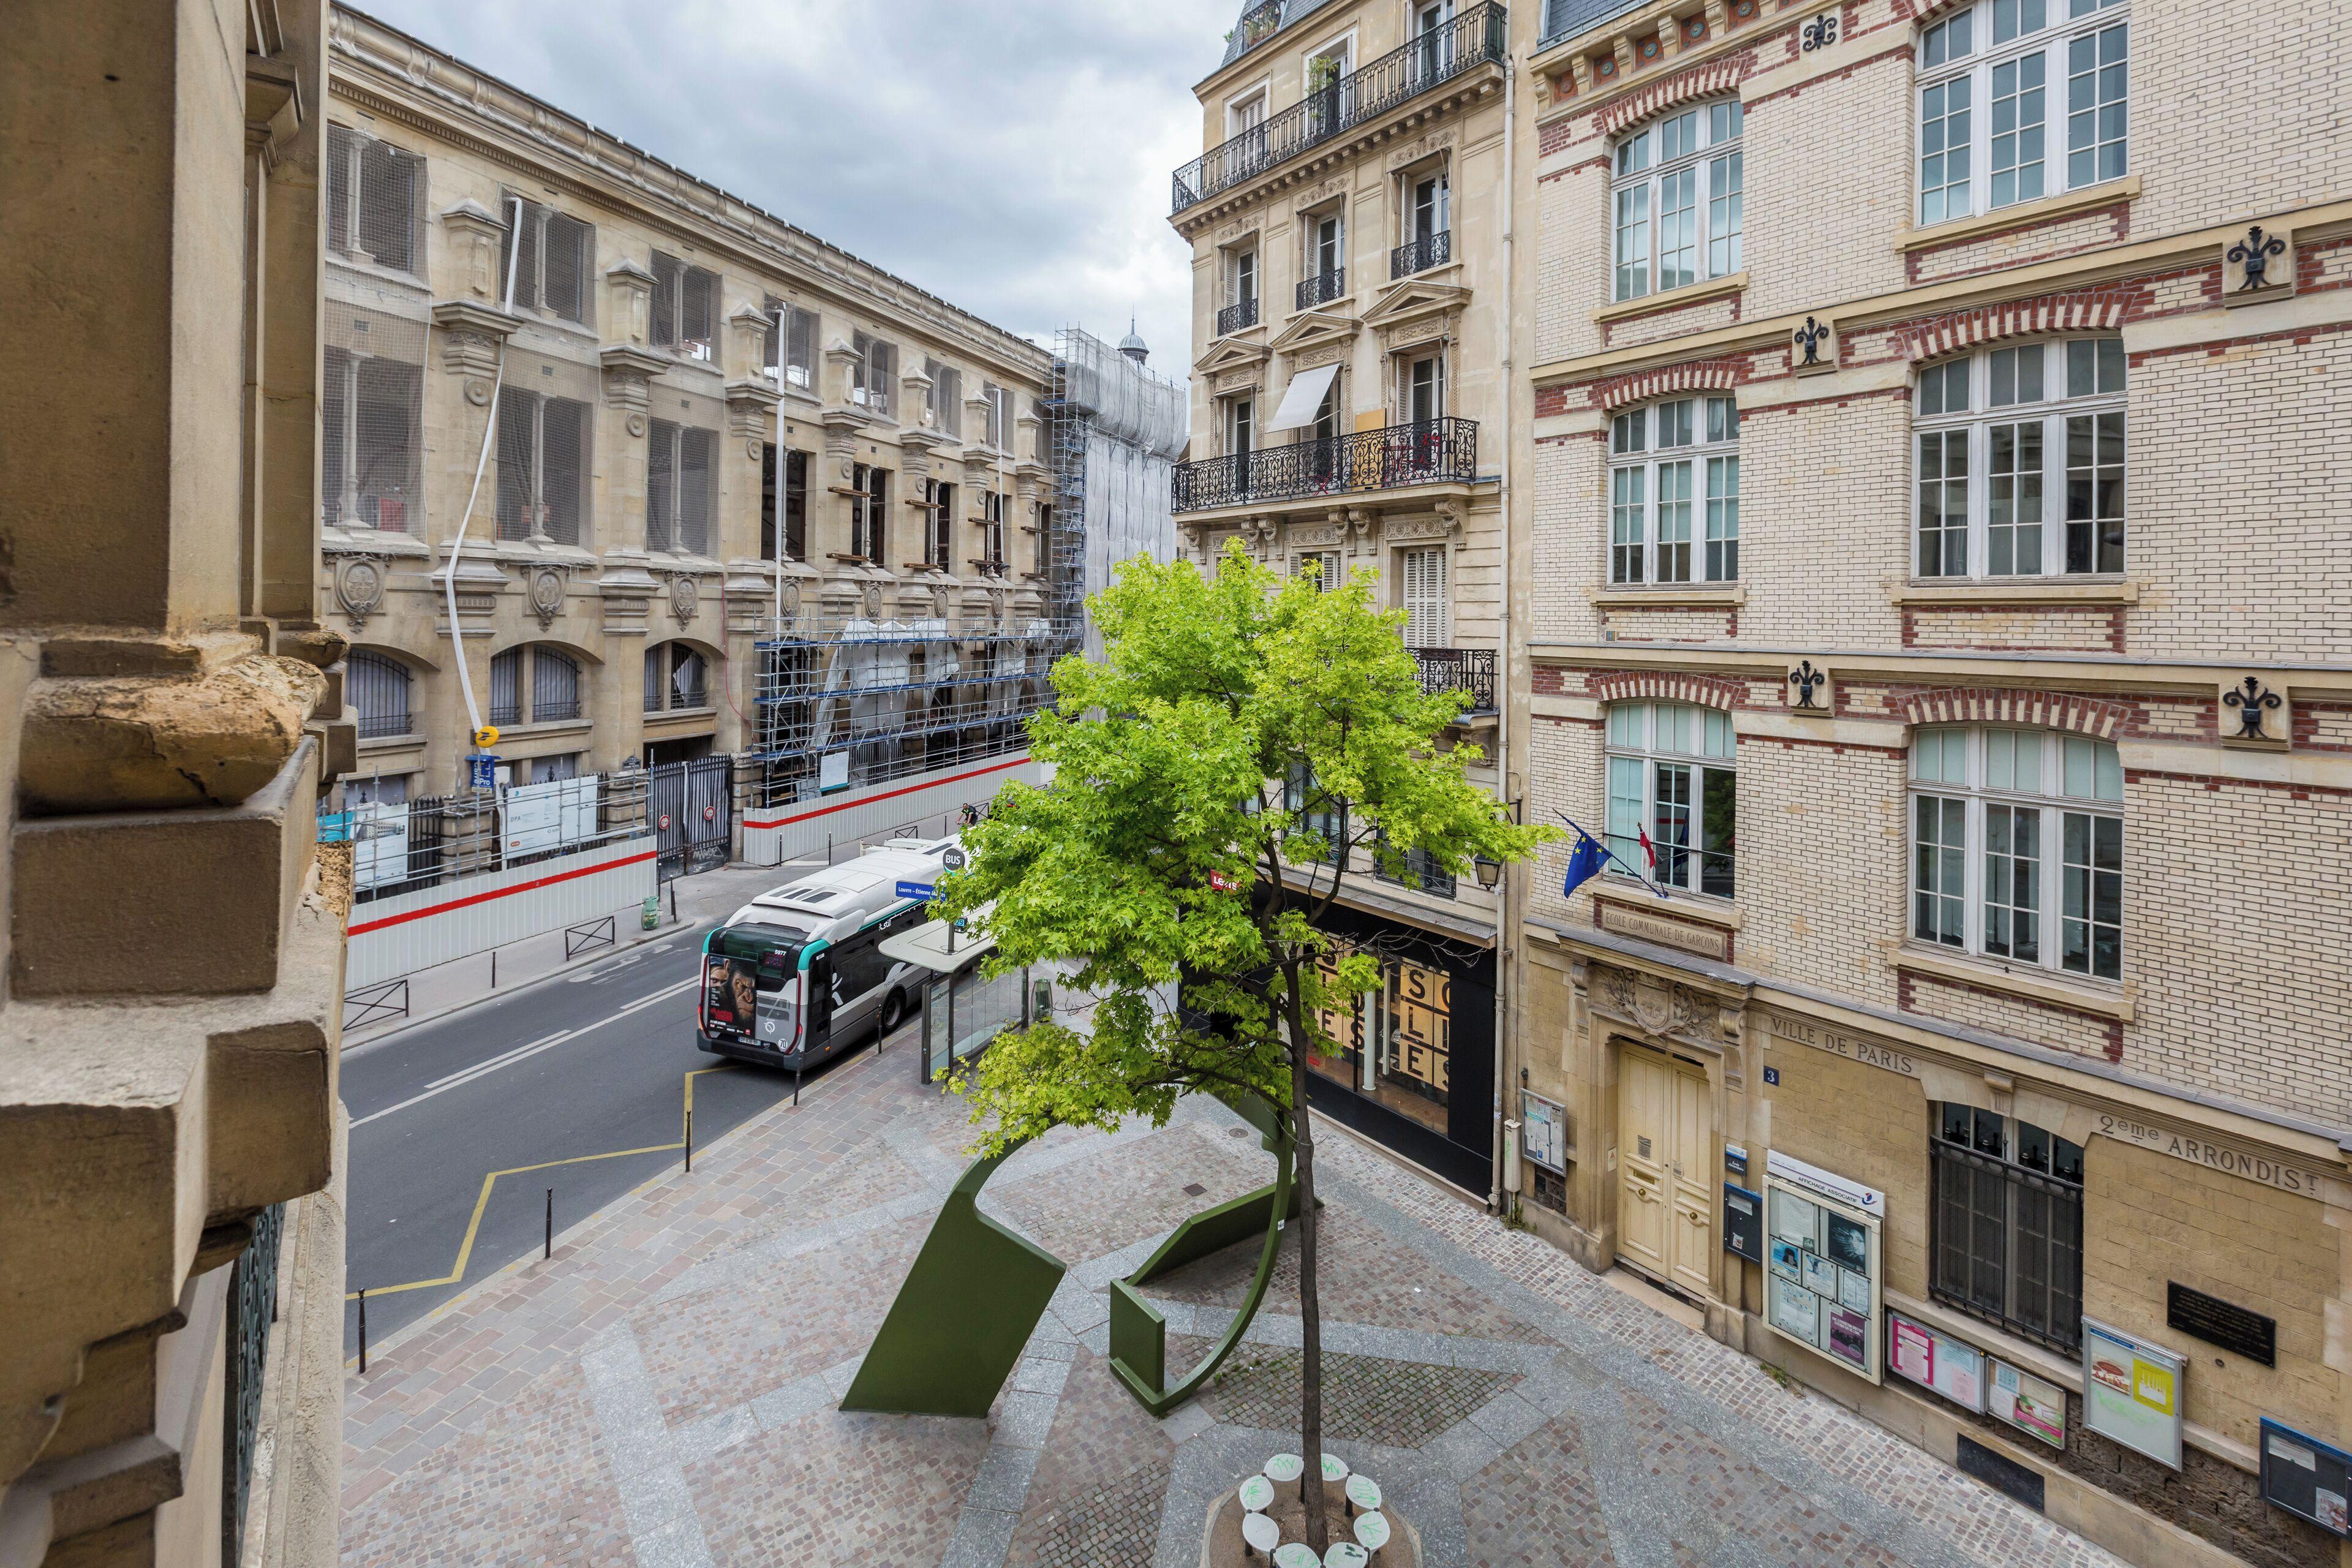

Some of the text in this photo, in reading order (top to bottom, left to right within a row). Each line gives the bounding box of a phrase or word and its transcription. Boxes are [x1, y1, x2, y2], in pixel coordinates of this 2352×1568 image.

[945, 854, 960, 865] BUS
[915, 888, 931, 896] Étienne
[1606, 912, 1720, 951] ECOLE COMMUNALE DE GARÇONS
[780, 1039, 786, 1049] 70
[1771, 1017, 1912, 1073] VILLE DE PARIS
[1767, 1070, 1775, 1083] 3
[1798, 1176, 1858, 1204] AFFICHAGE ASSOCIATIF
